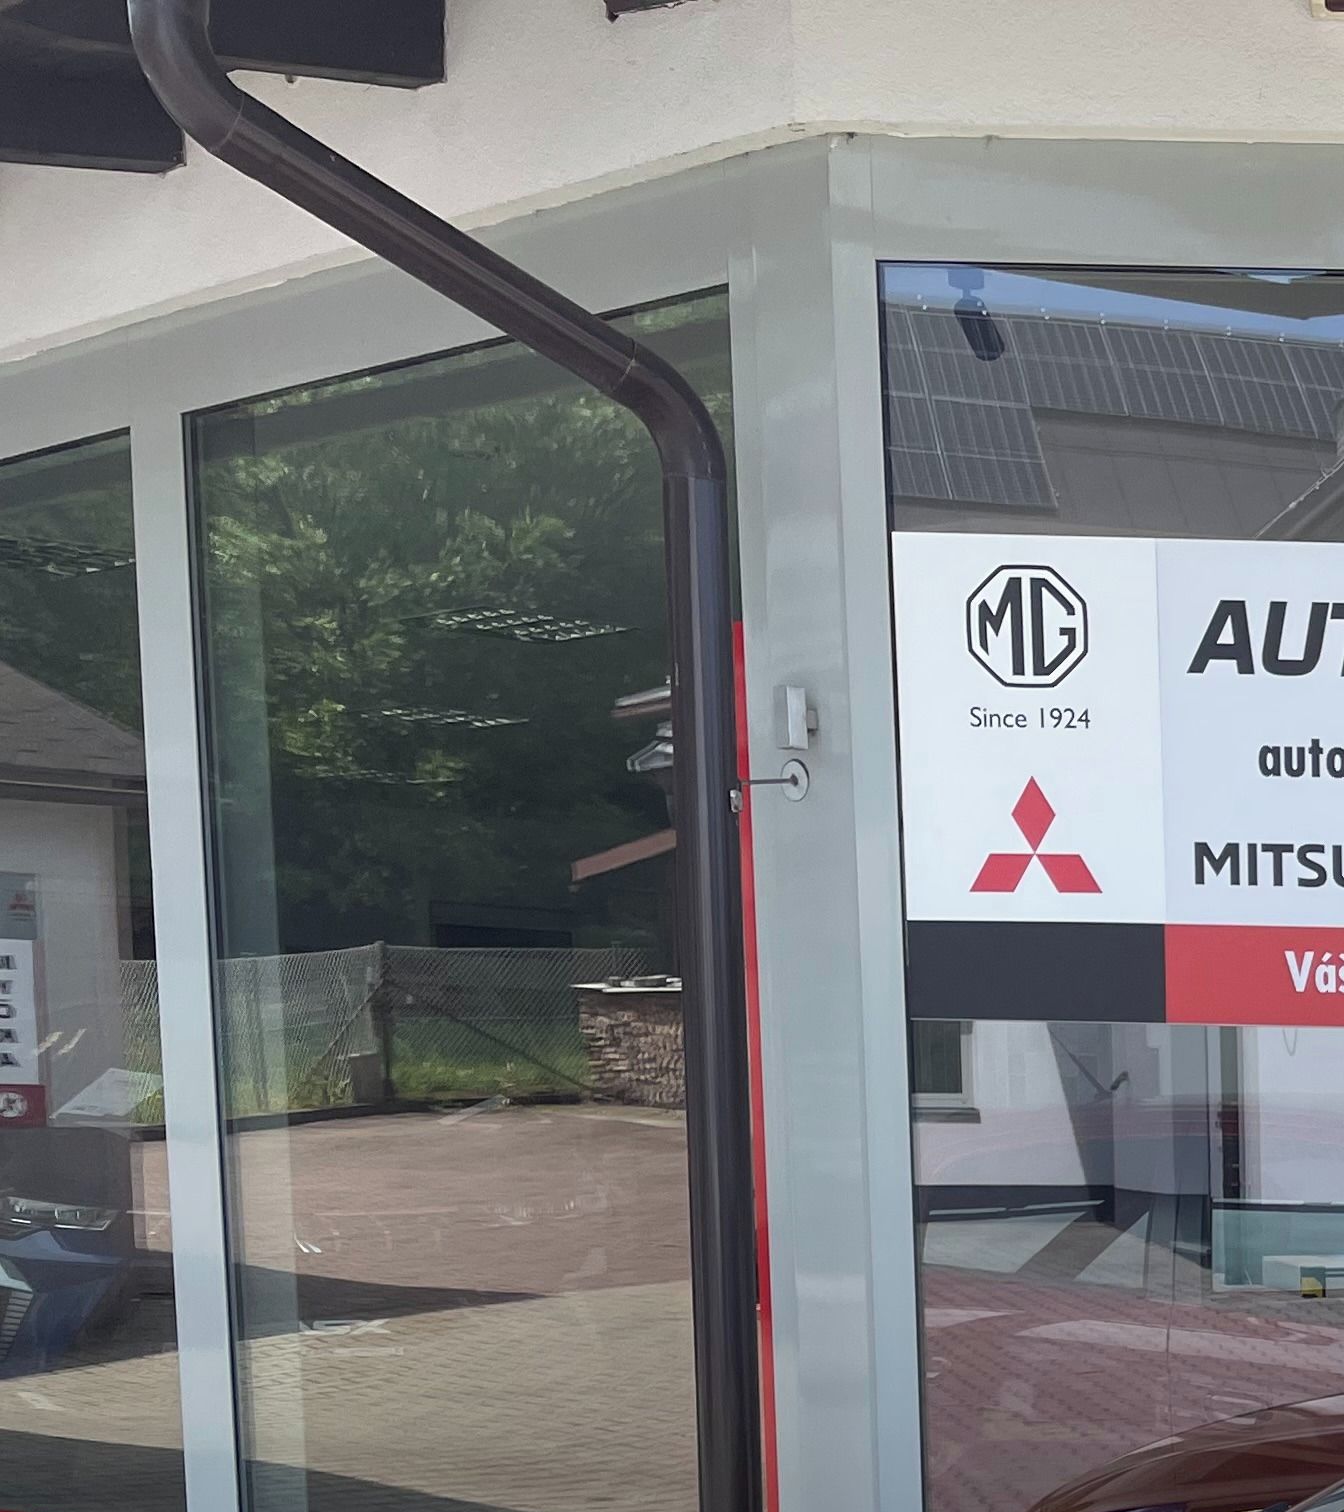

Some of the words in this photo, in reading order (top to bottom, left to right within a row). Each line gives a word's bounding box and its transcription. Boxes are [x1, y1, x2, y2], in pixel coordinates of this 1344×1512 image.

[976, 574, 1080, 679] MG
[970, 706, 1029, 729] Since
[1036, 706, 1091, 729] 1924
